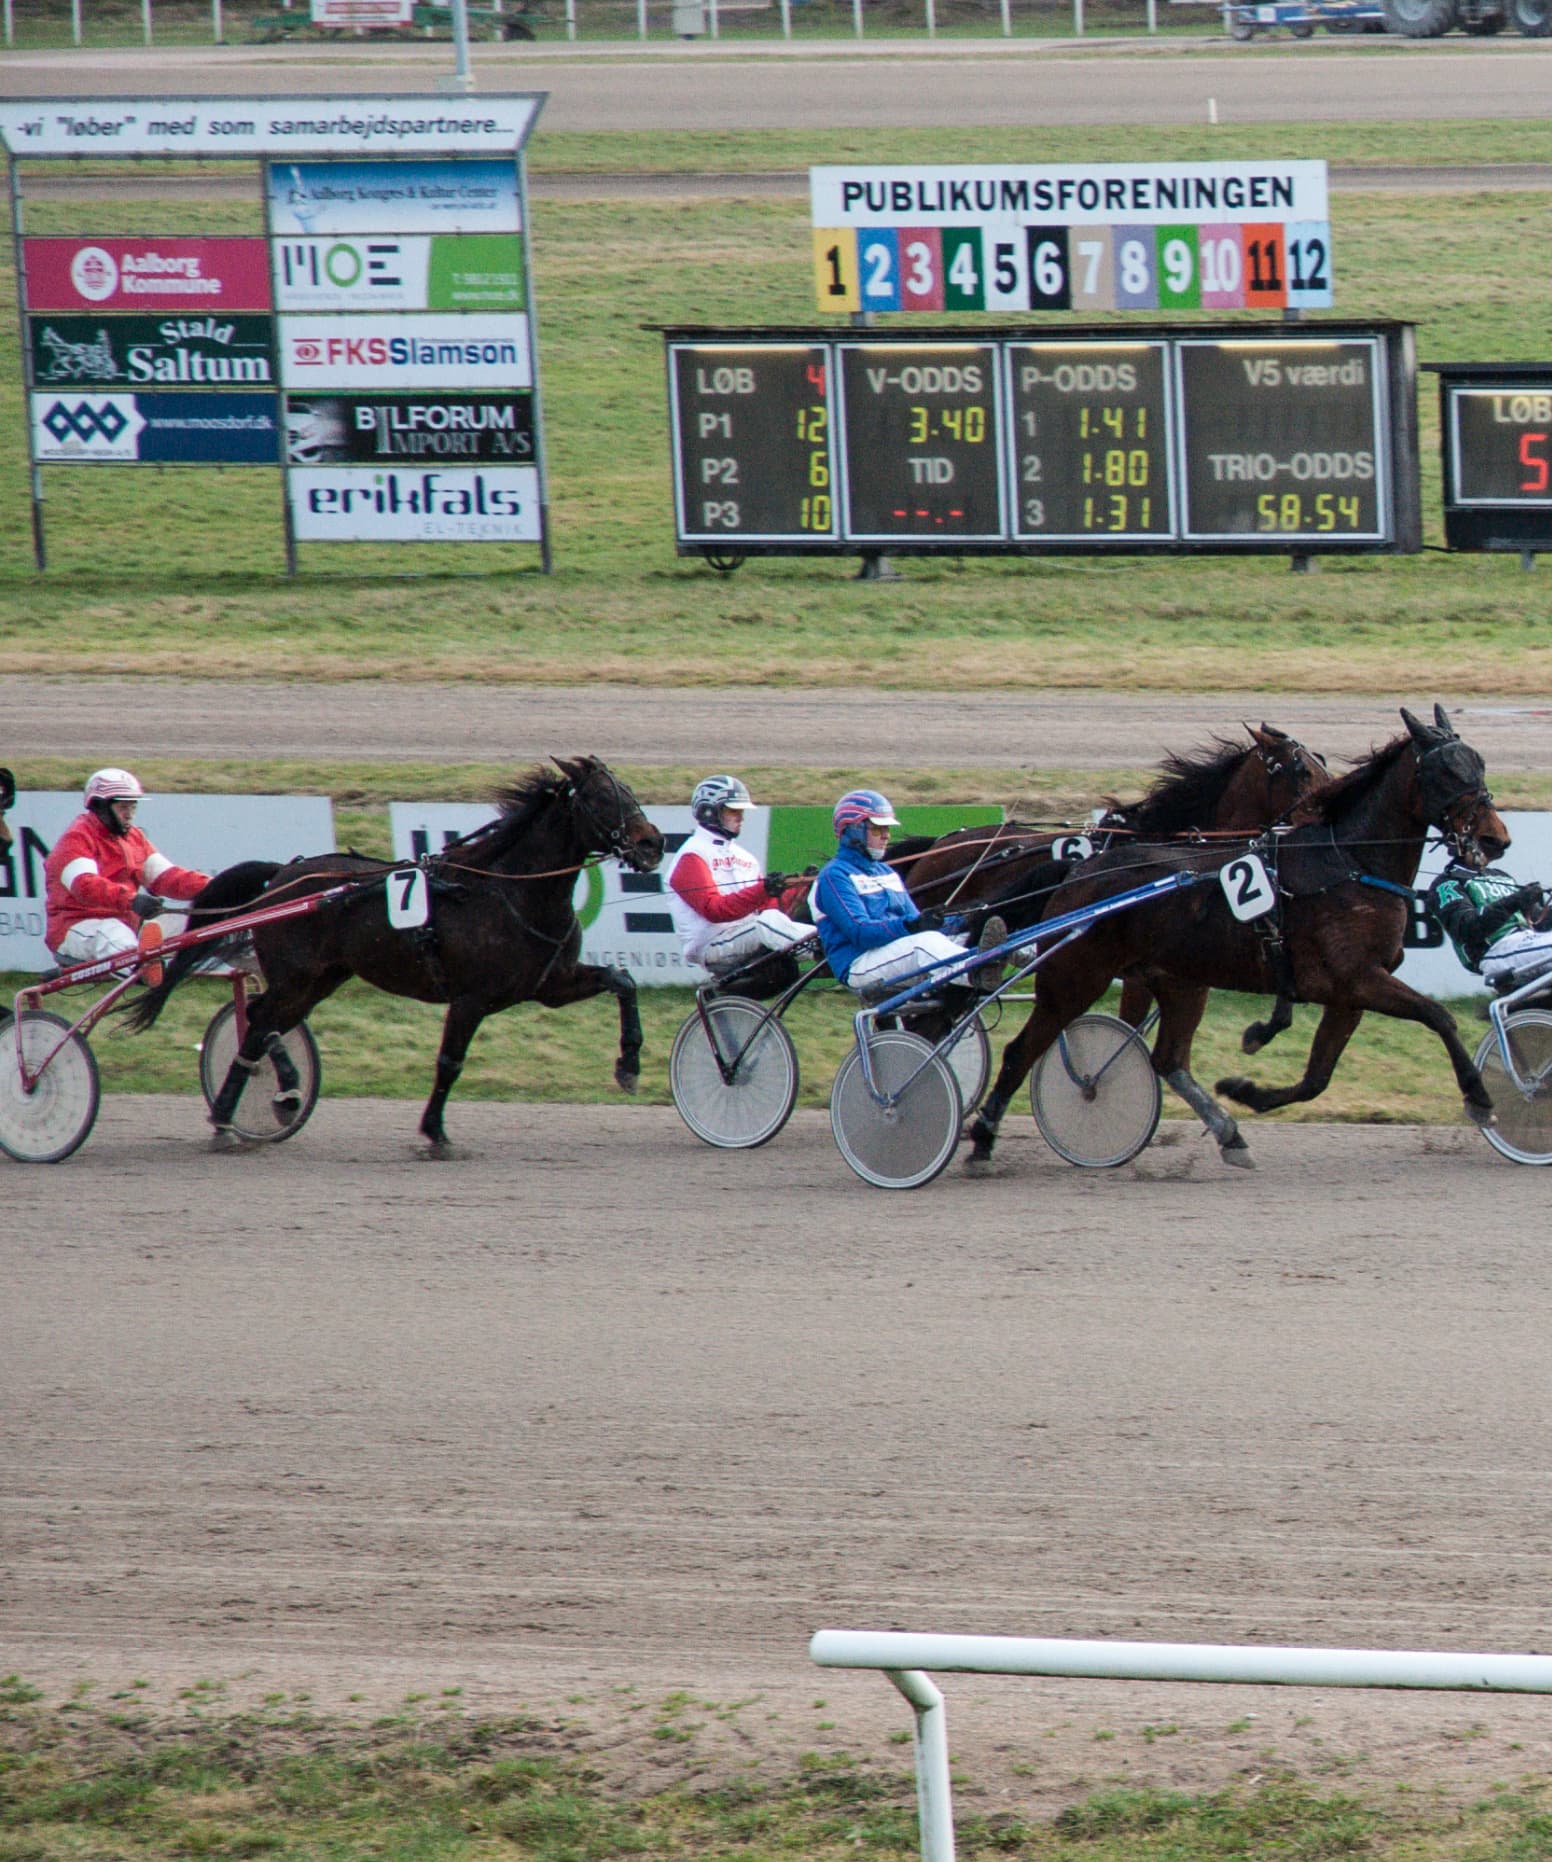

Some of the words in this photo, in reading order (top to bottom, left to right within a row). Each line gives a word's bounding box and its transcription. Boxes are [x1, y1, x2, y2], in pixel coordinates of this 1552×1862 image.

[148, 115, 198, 136] med
[207, 120, 256, 136] som
[841, 175, 1296, 213] PUBLIKUMSFORENINGEN
[121, 252, 201, 278] Aalborg
[282, 243, 403, 288] MOE
[826, 245, 847, 296] 1
[863, 242, 894, 297] 2
[905, 241, 934, 296] 3
[949, 242, 978, 296] 4
[994, 242, 1018, 294] 5
[1033, 240, 1064, 296] 6
[1077, 240, 1104, 295] 7
[1119, 239, 1150, 295] 8
[1163, 239, 1194, 294] 9
[1201, 237, 1242, 293] 10
[1247, 239, 1282, 292] 11
[1289, 238, 1328, 291] 12
[121, 277, 223, 295] Kommune
[158, 317, 236, 345] Stald
[126, 348, 273, 383] Saltum
[695, 367, 757, 394] LØB
[806, 364, 826, 397] 4
[866, 365, 983, 395] V-ODDS
[1020, 363, 1138, 393] P-ODDS
[1243, 358, 1281, 387] V5
[1285, 358, 1367, 387] værdi
[354, 405, 515, 430] BILFORUM
[699, 412, 733, 439] P1
[796, 405, 827, 443] 12
[908, 405, 986, 443] 3.40
[1022, 410, 1038, 438] 1
[1079, 406, 1148, 439] 1.41
[1492, 395, 1552, 425] LØB
[491, 431, 532, 454] A/S
[701, 457, 739, 484] P2
[808, 450, 829, 488] 6
[906, 457, 955, 485] TID
[1023, 455, 1043, 483] 2
[1082, 449, 1149, 487] 1.80
[1207, 451, 1375, 481] TRIO-ODDS
[1518, 432, 1550, 492] 5
[307, 473, 521, 516] erikfals
[703, 501, 741, 528] P3
[800, 494, 831, 531] 10
[1025, 499, 1046, 527] 3
[1083, 494, 1151, 531] 1.31
[1256, 493, 1360, 532] 58.54
[394, 869, 417, 911] 7
[1228, 860, 1263, 906] 2
[1436, 880, 1465, 909] K
